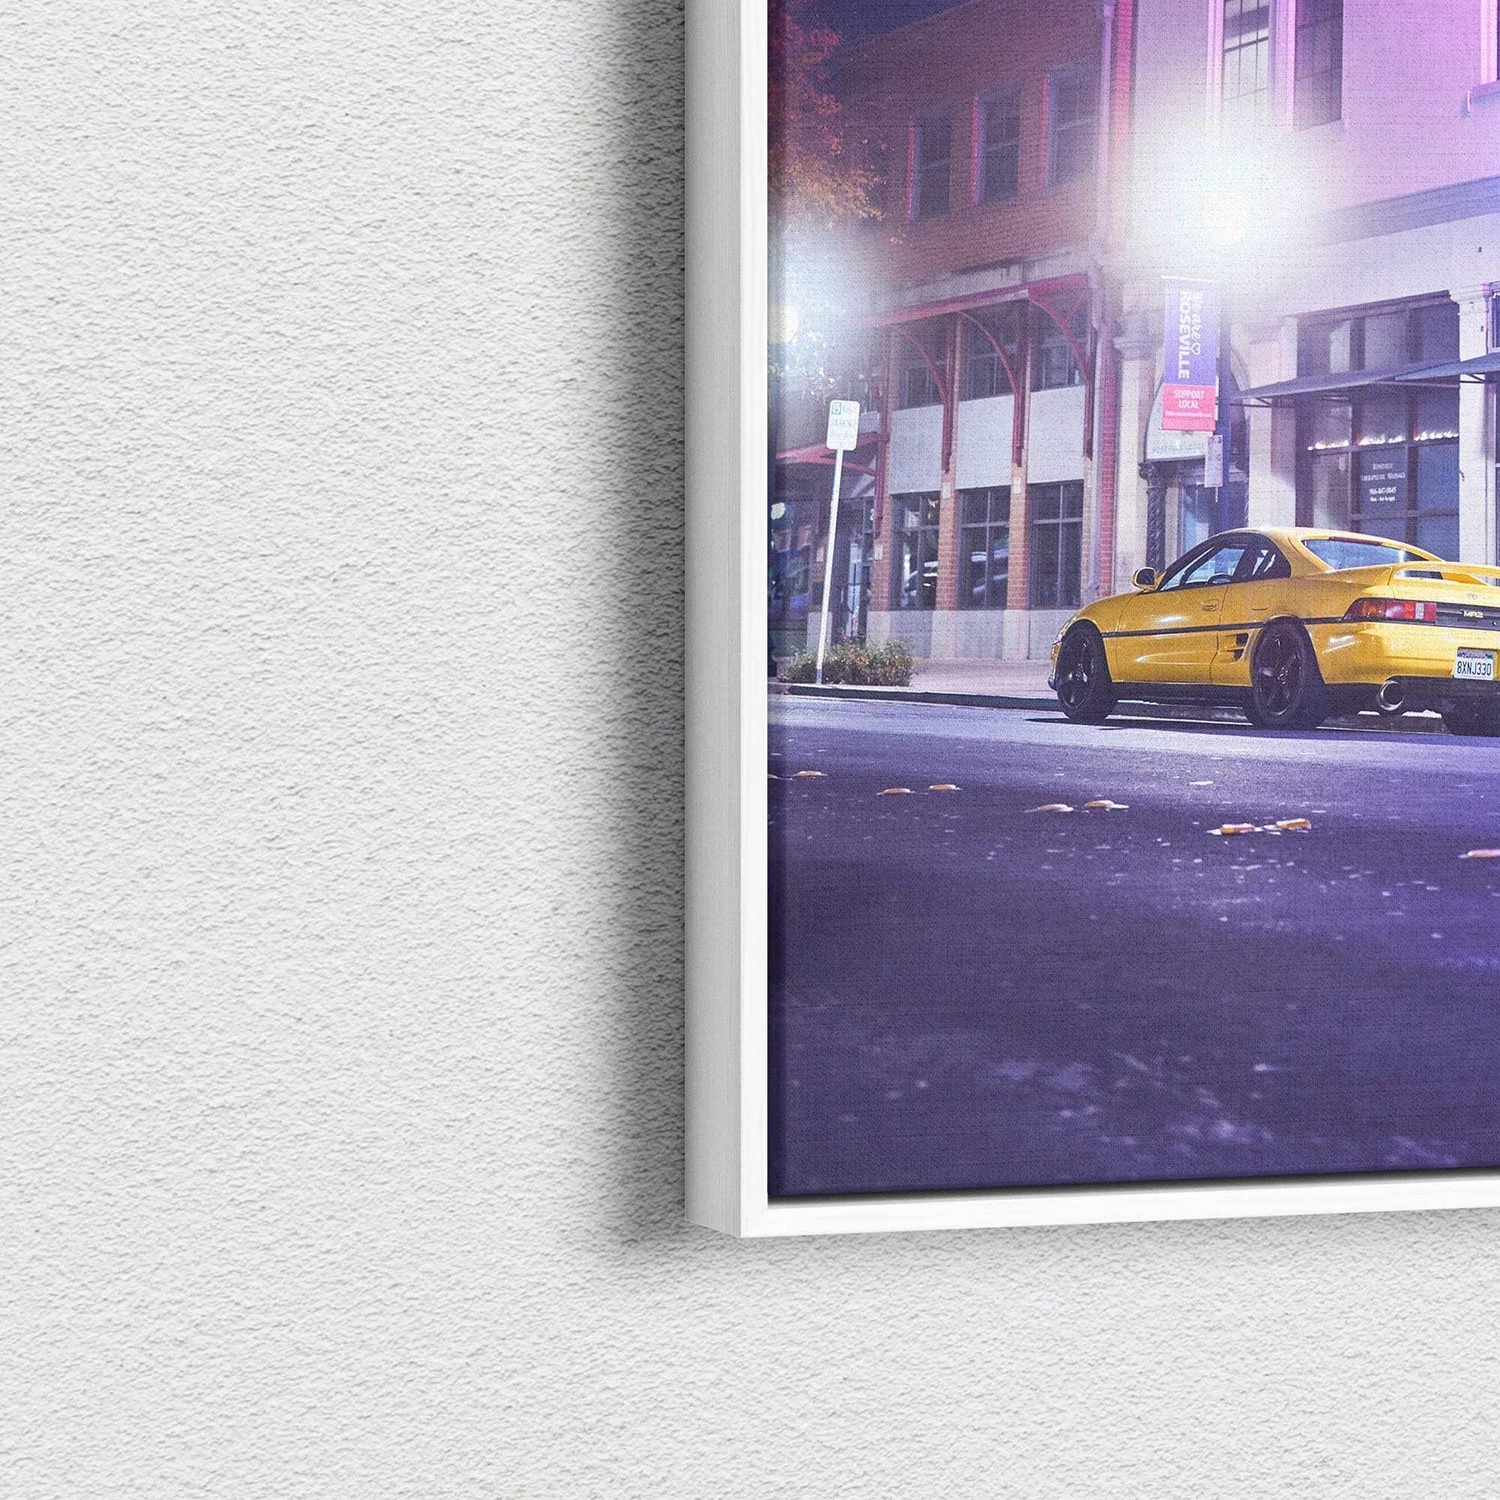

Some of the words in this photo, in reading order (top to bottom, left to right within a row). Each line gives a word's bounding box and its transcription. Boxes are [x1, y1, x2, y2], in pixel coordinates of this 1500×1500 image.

[1178, 291, 1191, 379] ROSEVILLE
[1173, 389, 1205, 400] SUPPORT
[1178, 399, 1200, 409] LOCAL
[1457, 660, 1492, 676] 8XNJ330
